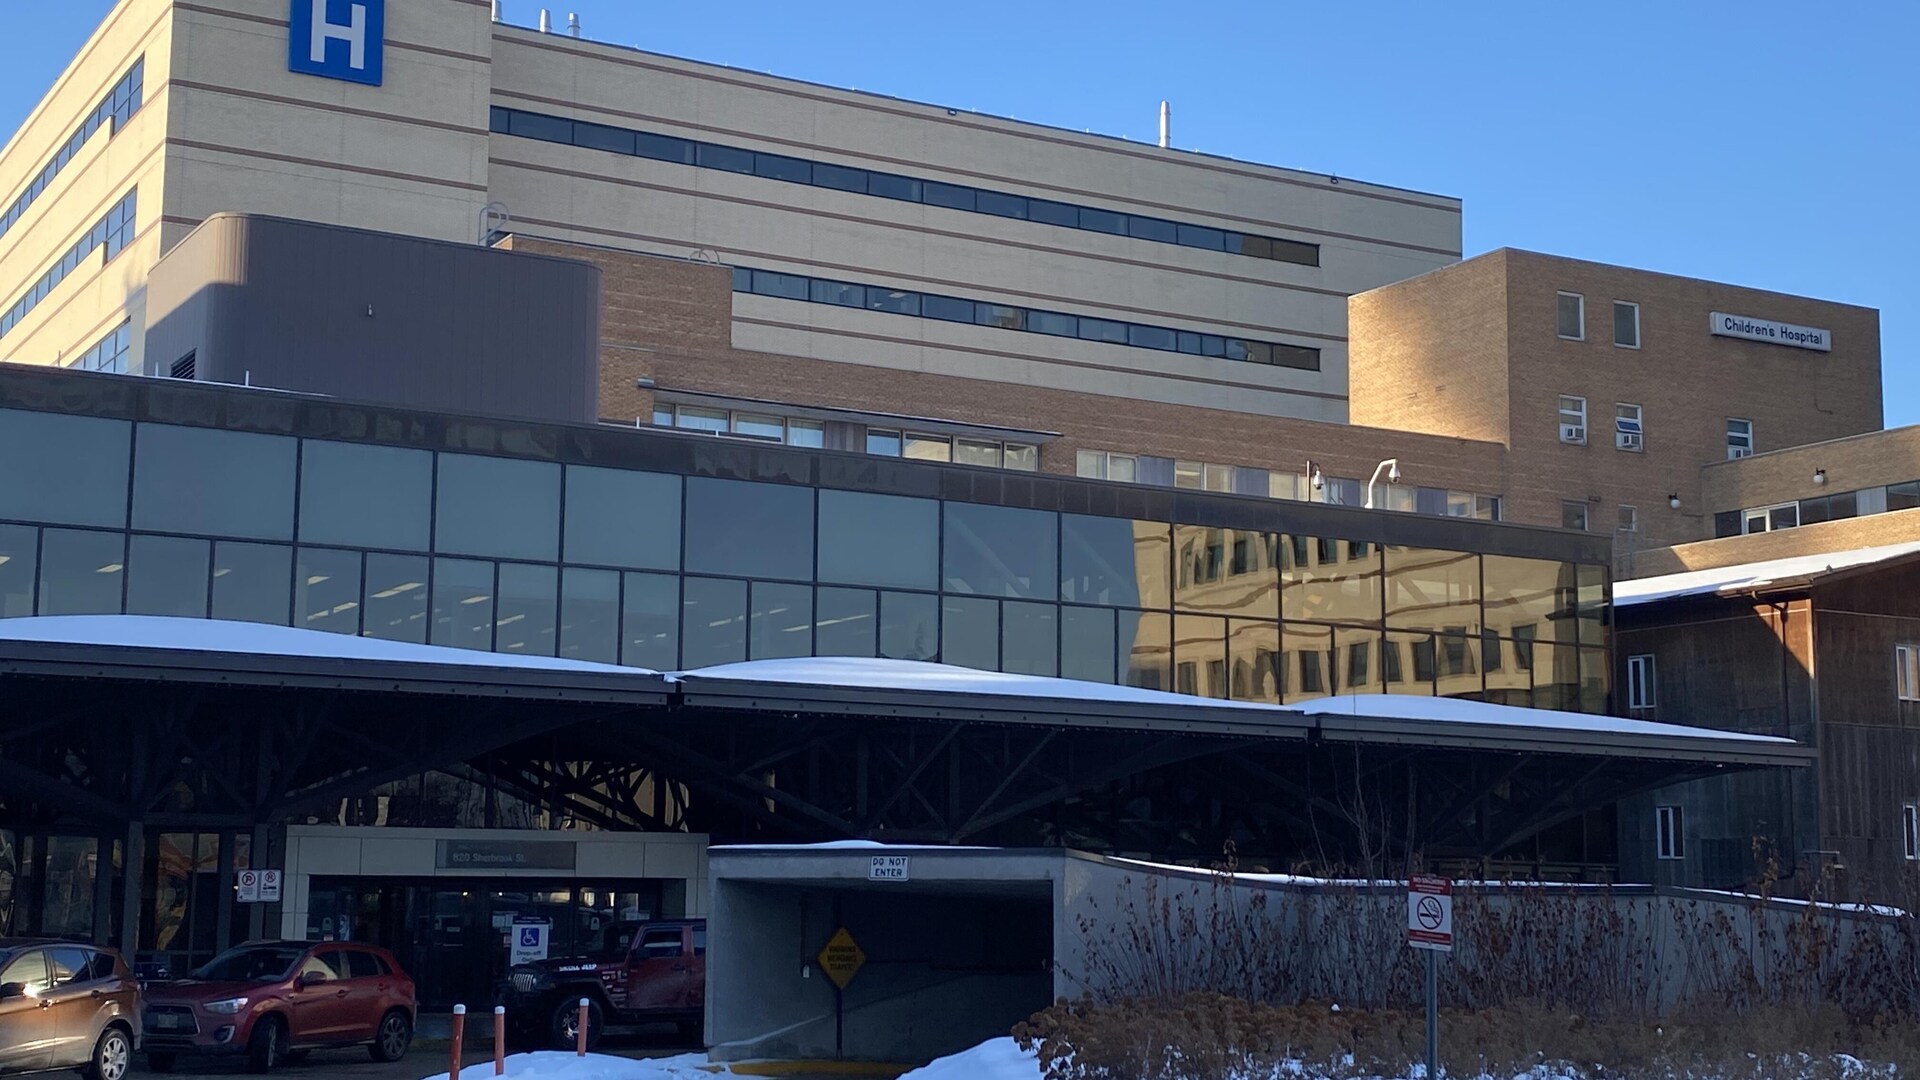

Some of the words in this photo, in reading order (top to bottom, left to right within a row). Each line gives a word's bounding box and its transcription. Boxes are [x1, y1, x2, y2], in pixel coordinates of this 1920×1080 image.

[310, 0, 366, 70] H
[1724, 317, 1775, 337] Children's
[1780, 326, 1823, 345] Hospital
[872, 857, 884, 866] DO
[889, 857, 906, 866] NOT
[875, 868, 902, 877] ENTER
